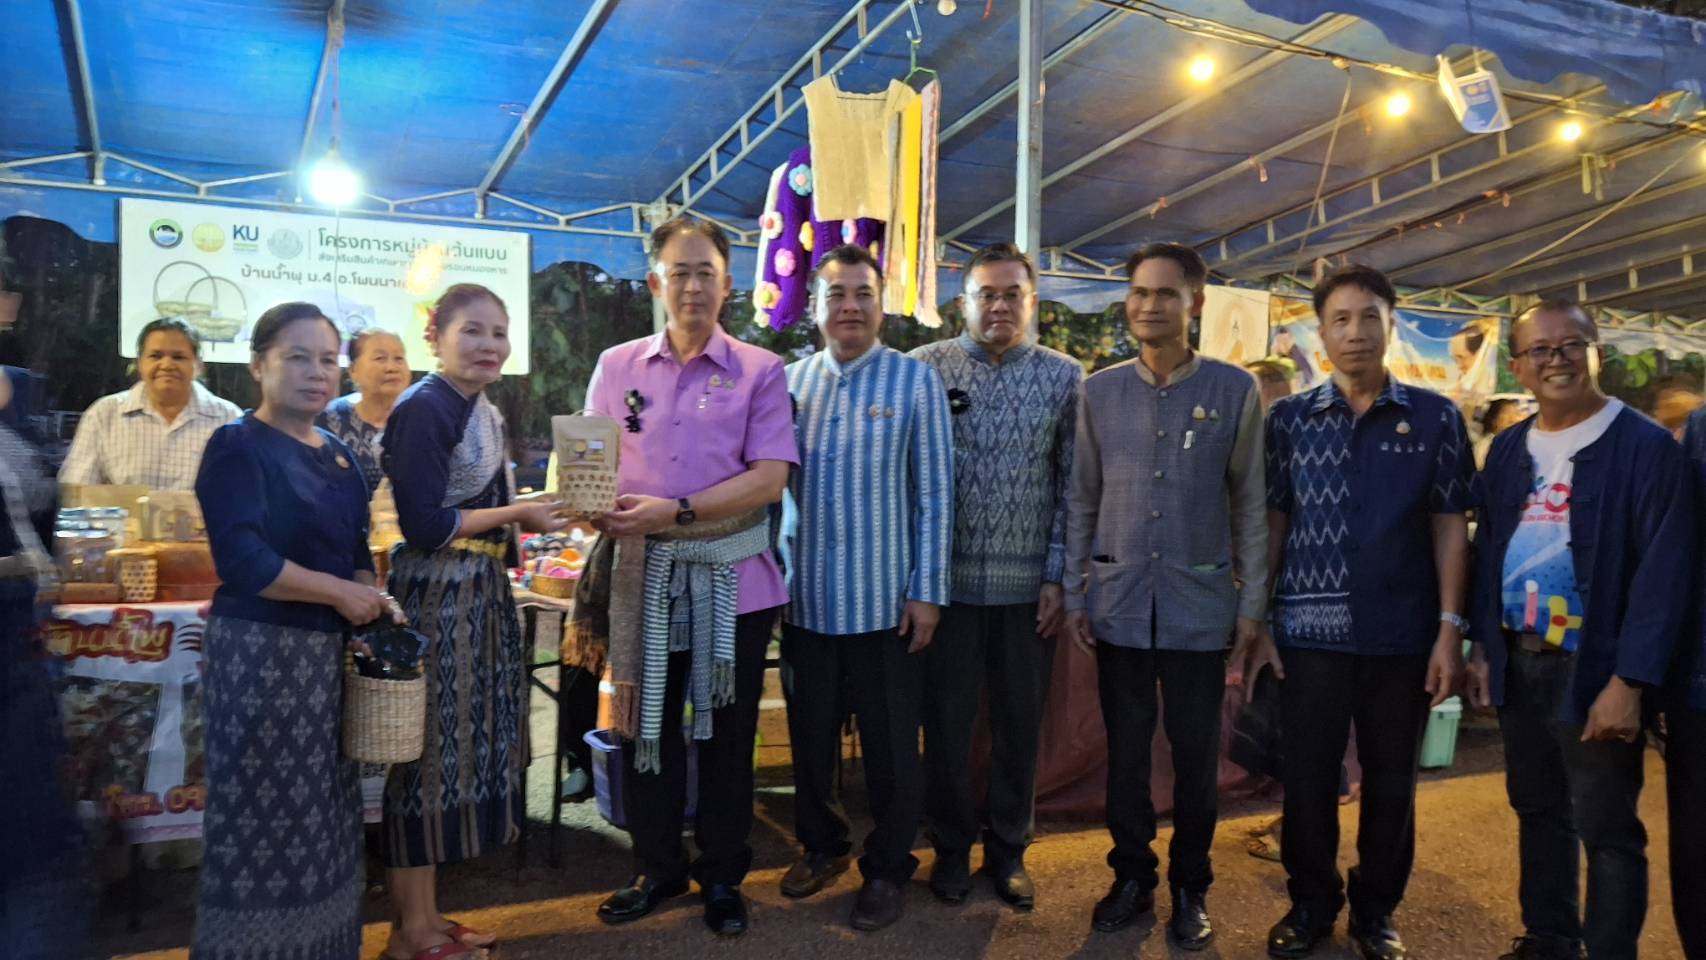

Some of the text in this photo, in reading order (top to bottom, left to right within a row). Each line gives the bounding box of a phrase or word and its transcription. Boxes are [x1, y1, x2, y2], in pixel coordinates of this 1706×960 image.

[233, 223, 259, 241] KU
[317, 227, 508, 262] โครงการหมู่บ้นต้นแบบ
